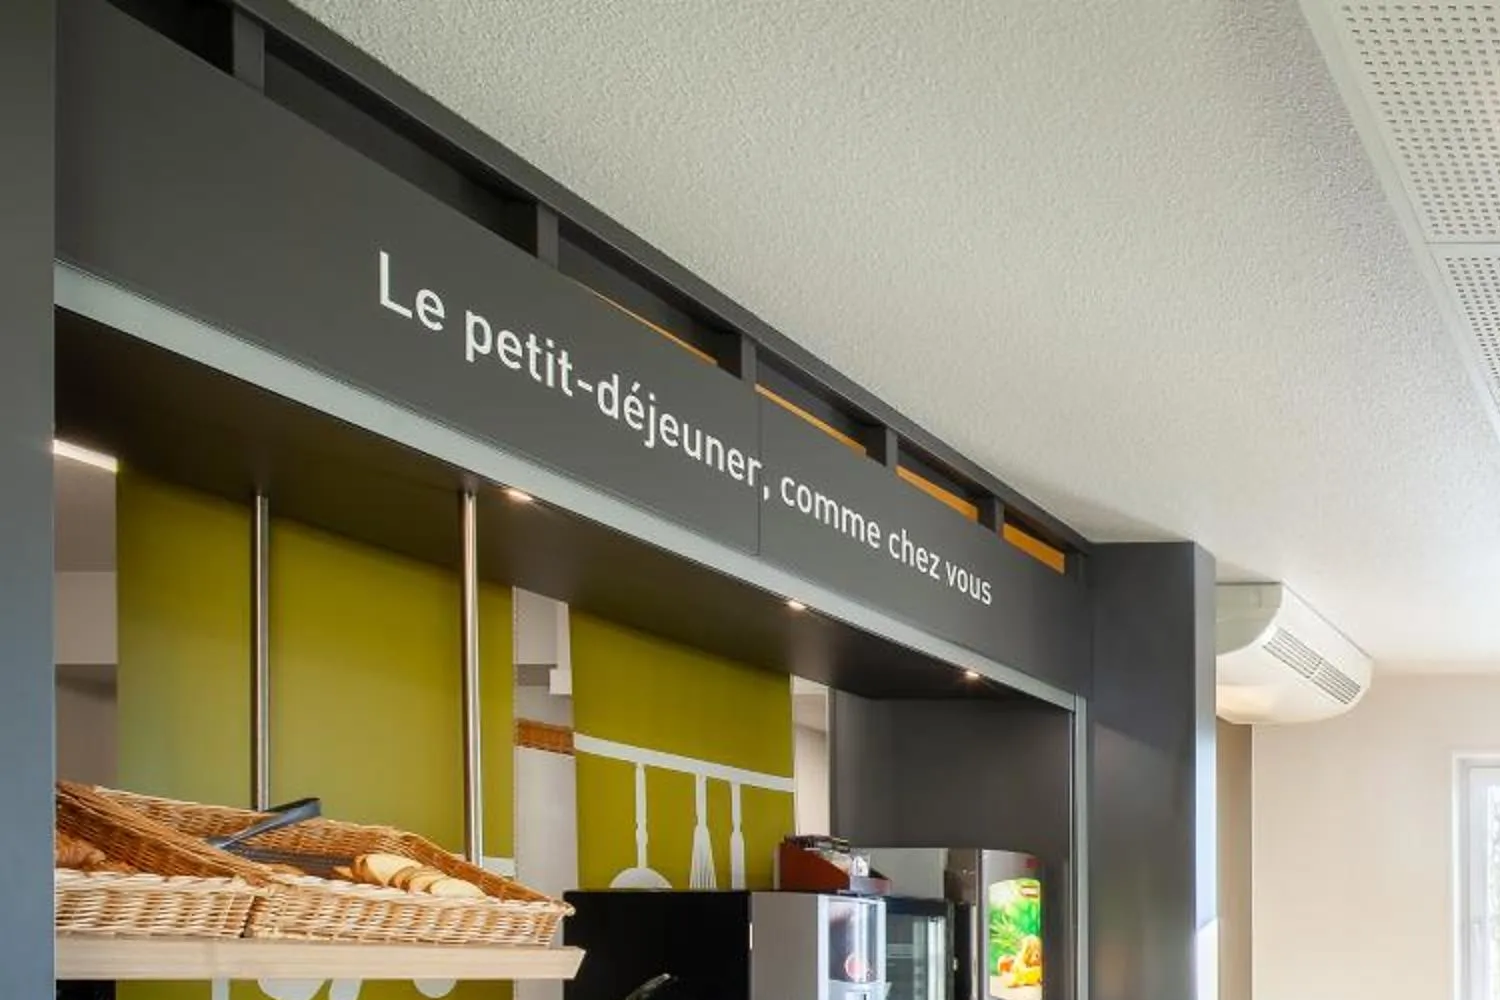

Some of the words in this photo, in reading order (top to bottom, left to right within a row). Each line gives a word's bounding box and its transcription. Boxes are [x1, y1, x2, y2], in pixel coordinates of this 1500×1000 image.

[379, 250, 446, 331] Le
[465, 309, 771, 502] petit-déjeuner,
[779, 475, 882, 550] comme
[887, 527, 941, 581] chez
[944, 560, 993, 606] vous
